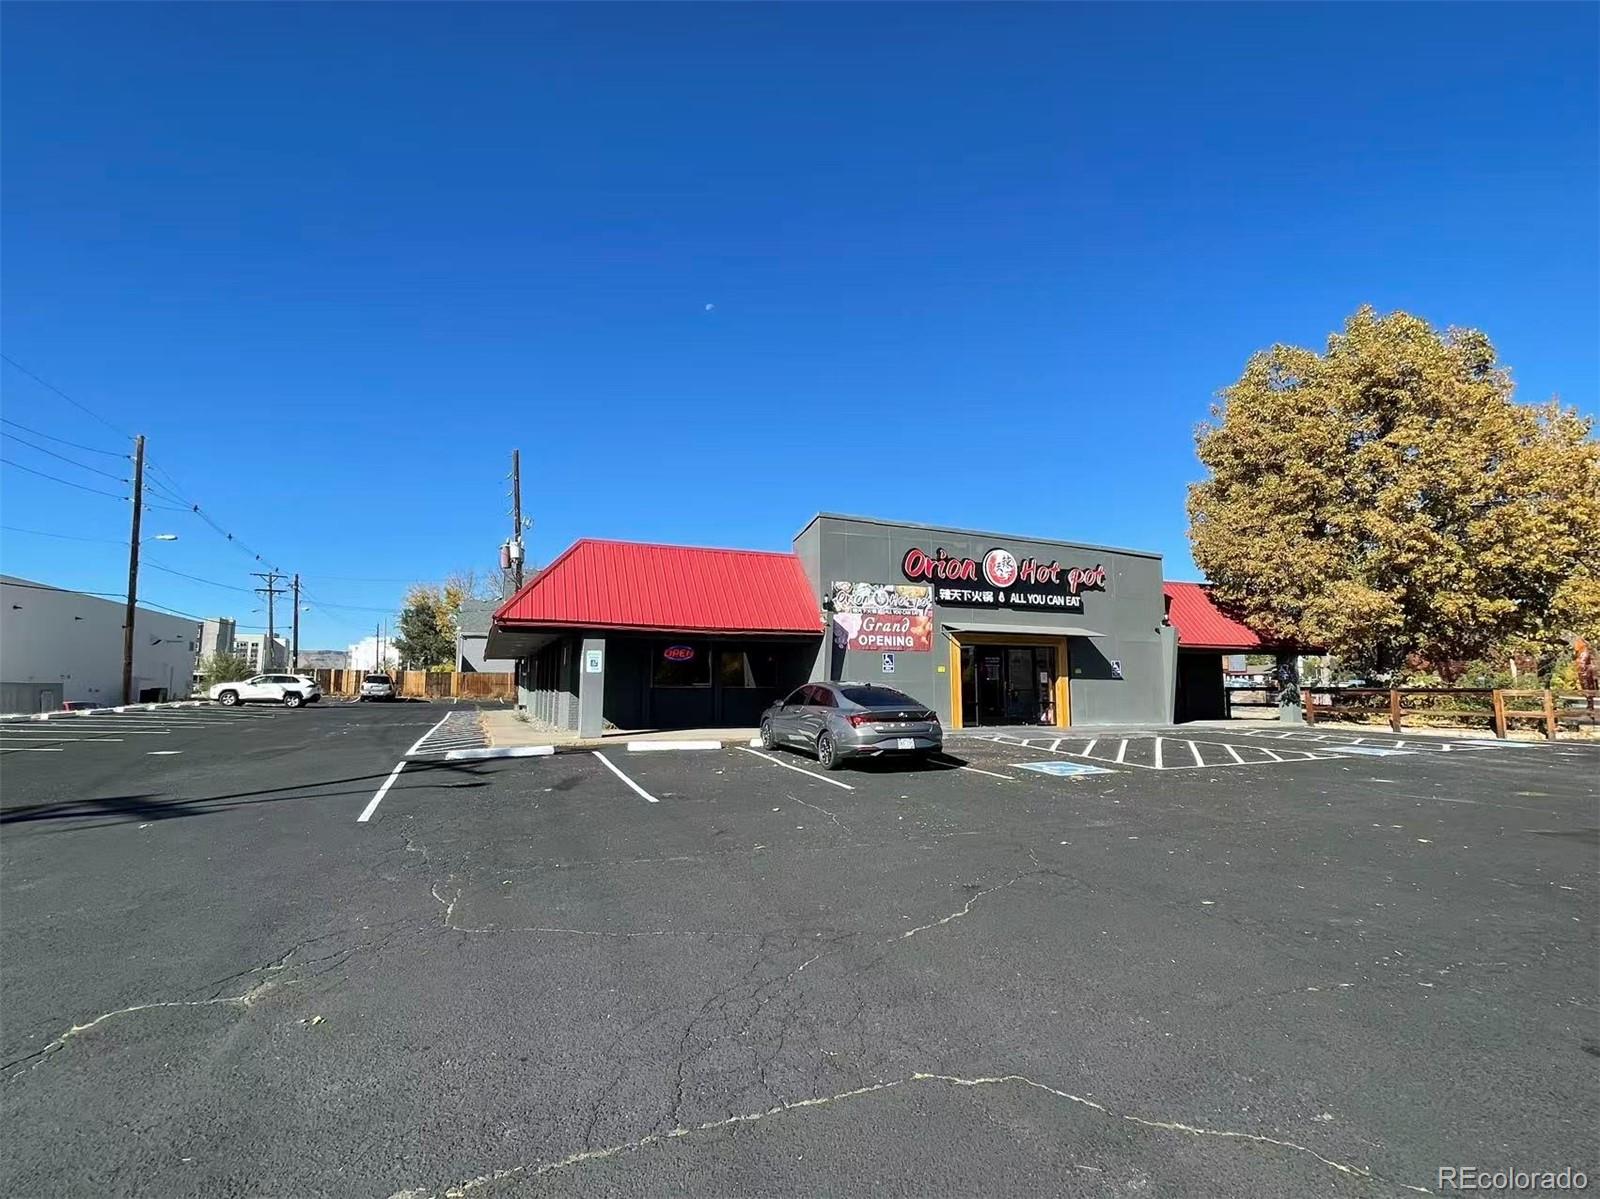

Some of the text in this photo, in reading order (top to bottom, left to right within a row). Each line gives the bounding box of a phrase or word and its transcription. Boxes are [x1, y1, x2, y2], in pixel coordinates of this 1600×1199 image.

[904, 549, 978, 581] Orion
[1020, 558, 1061, 584] Hot
[1067, 565, 1105, 594] pot
[1010, 592, 1081, 607] ALL YOU CAN EAT
[862, 616, 910, 633] Grand
[858, 634, 914, 647] OPENING
